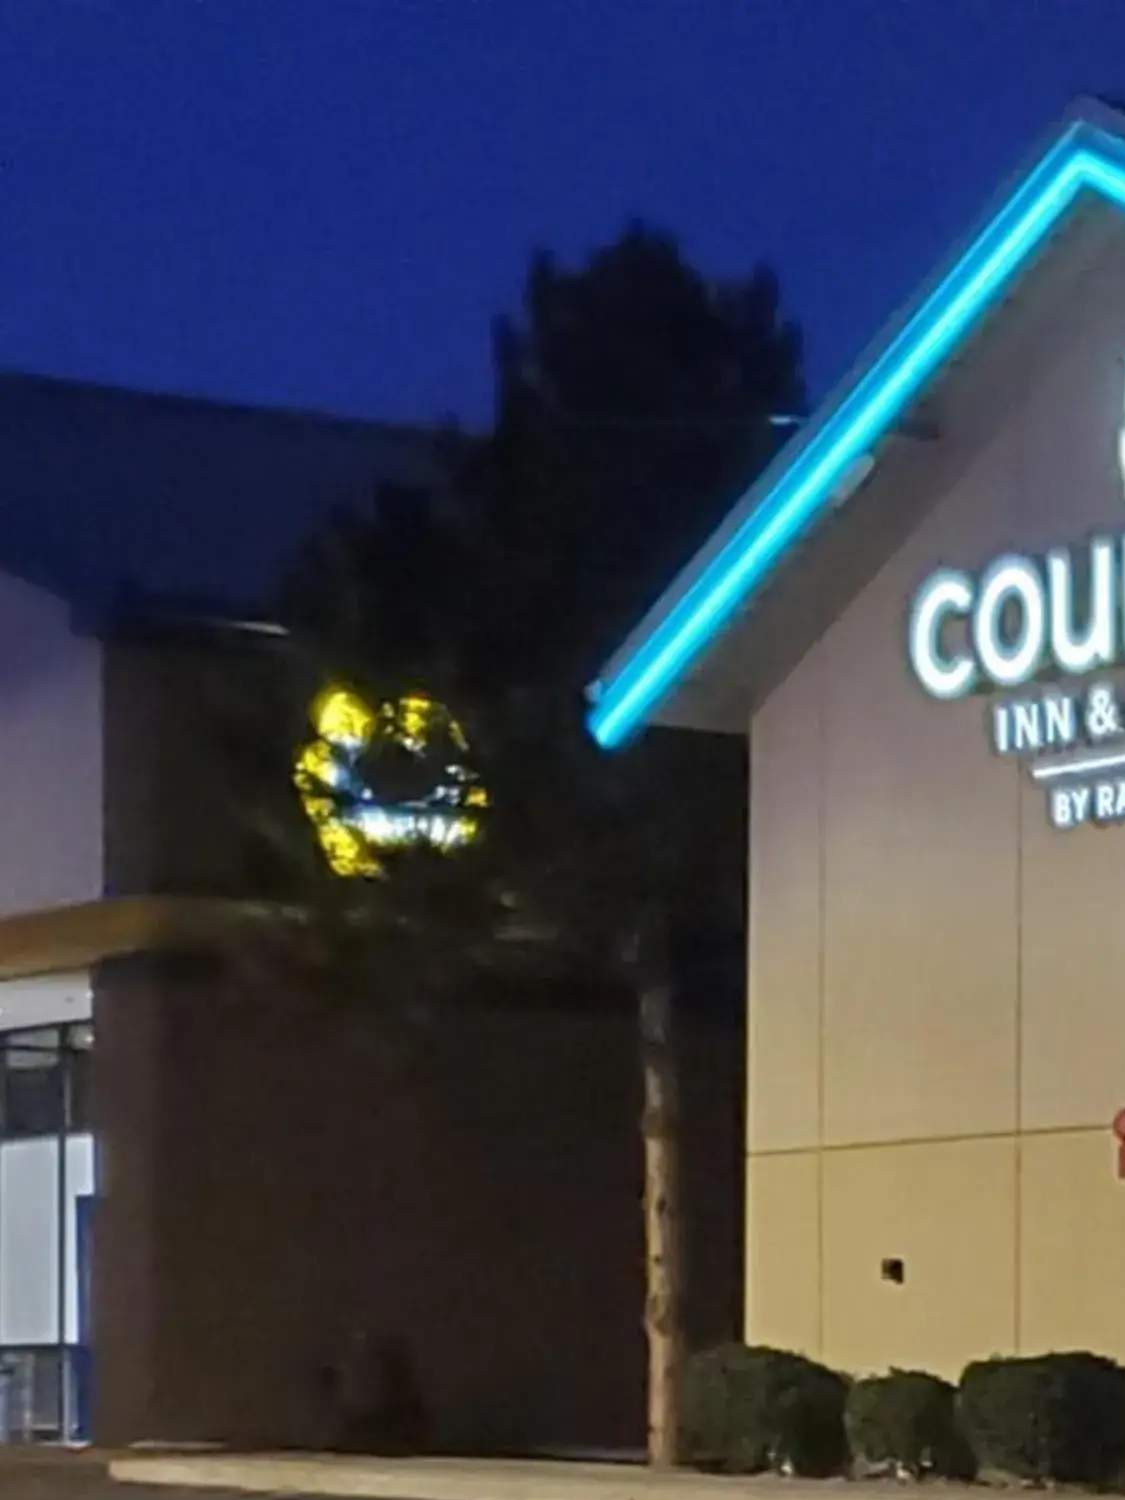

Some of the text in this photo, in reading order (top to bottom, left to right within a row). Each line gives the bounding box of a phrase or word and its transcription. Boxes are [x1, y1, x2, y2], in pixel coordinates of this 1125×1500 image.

[993, 697, 1074, 754] INN
[1085, 690, 1118, 736] &
[1052, 786, 1092, 826] BY
